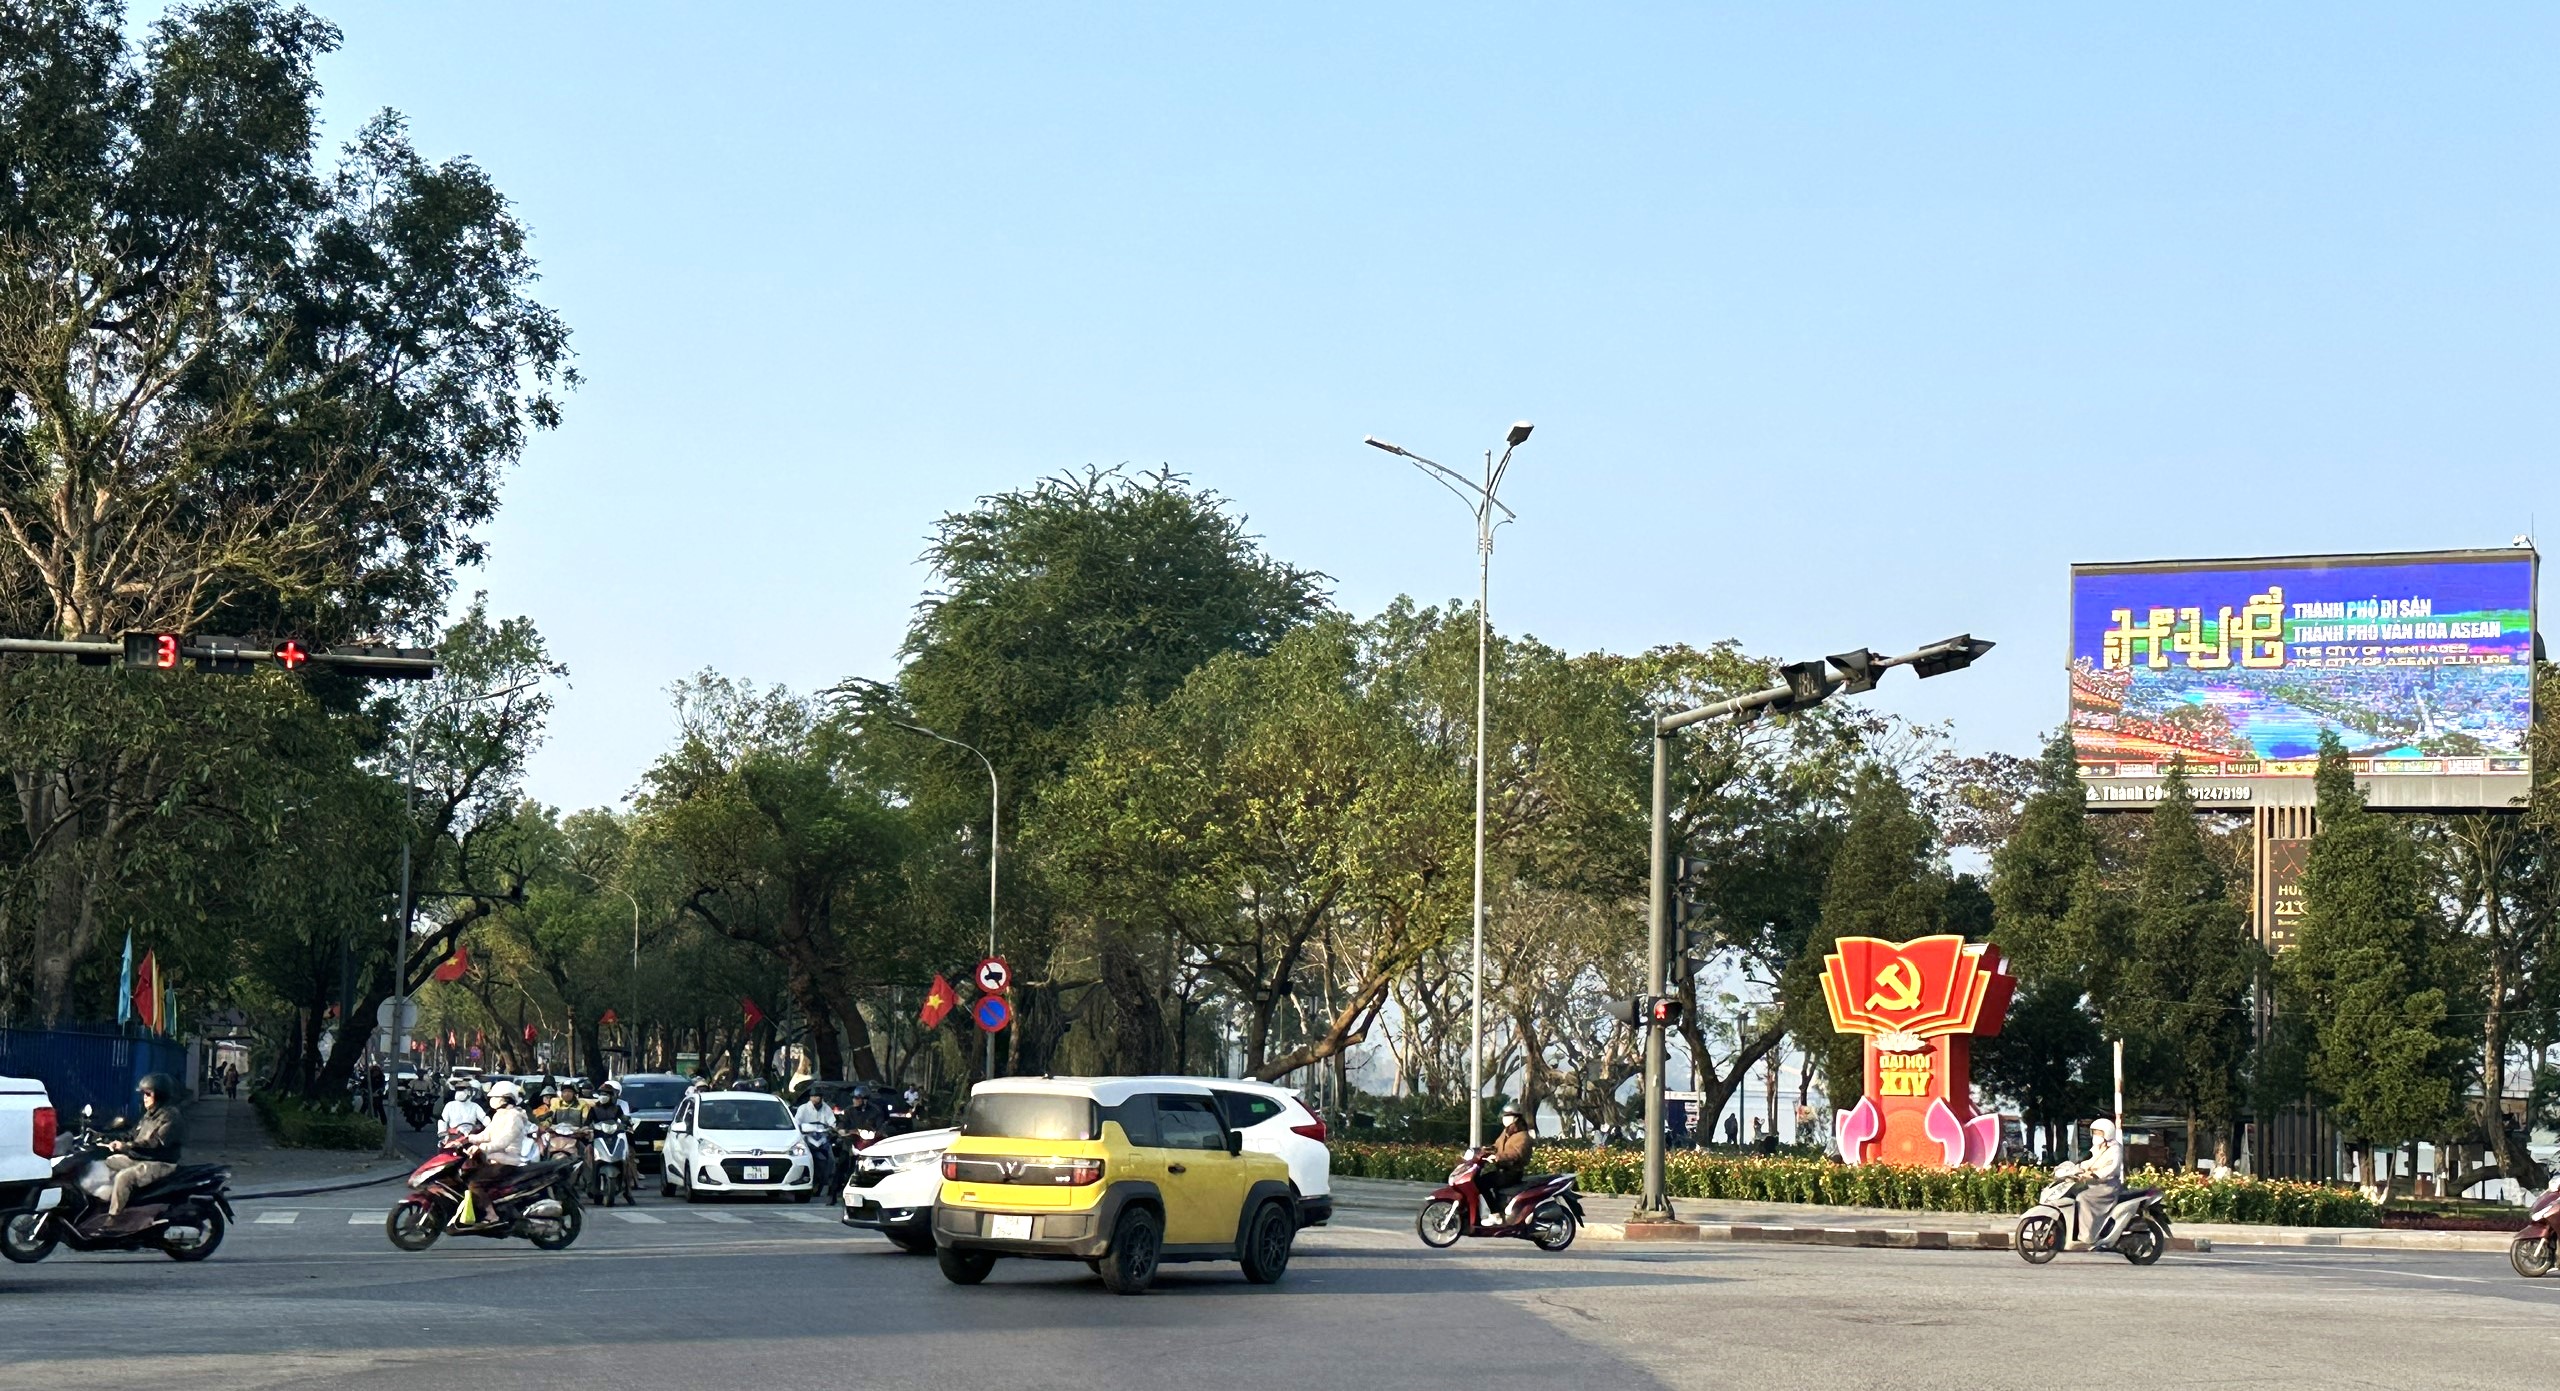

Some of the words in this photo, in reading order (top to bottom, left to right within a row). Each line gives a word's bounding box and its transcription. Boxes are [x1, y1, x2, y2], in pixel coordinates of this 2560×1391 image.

[2381, 599, 2398, 618] DI
[2450, 620, 2501, 639] ASEAN
[157, 635, 175, 667] 3
[2293, 646, 2322, 657] THE
[2325, 645, 2359, 656] CITY
[2293, 658, 2322, 668] THE
[1879, 1071, 1931, 1097] XIV
